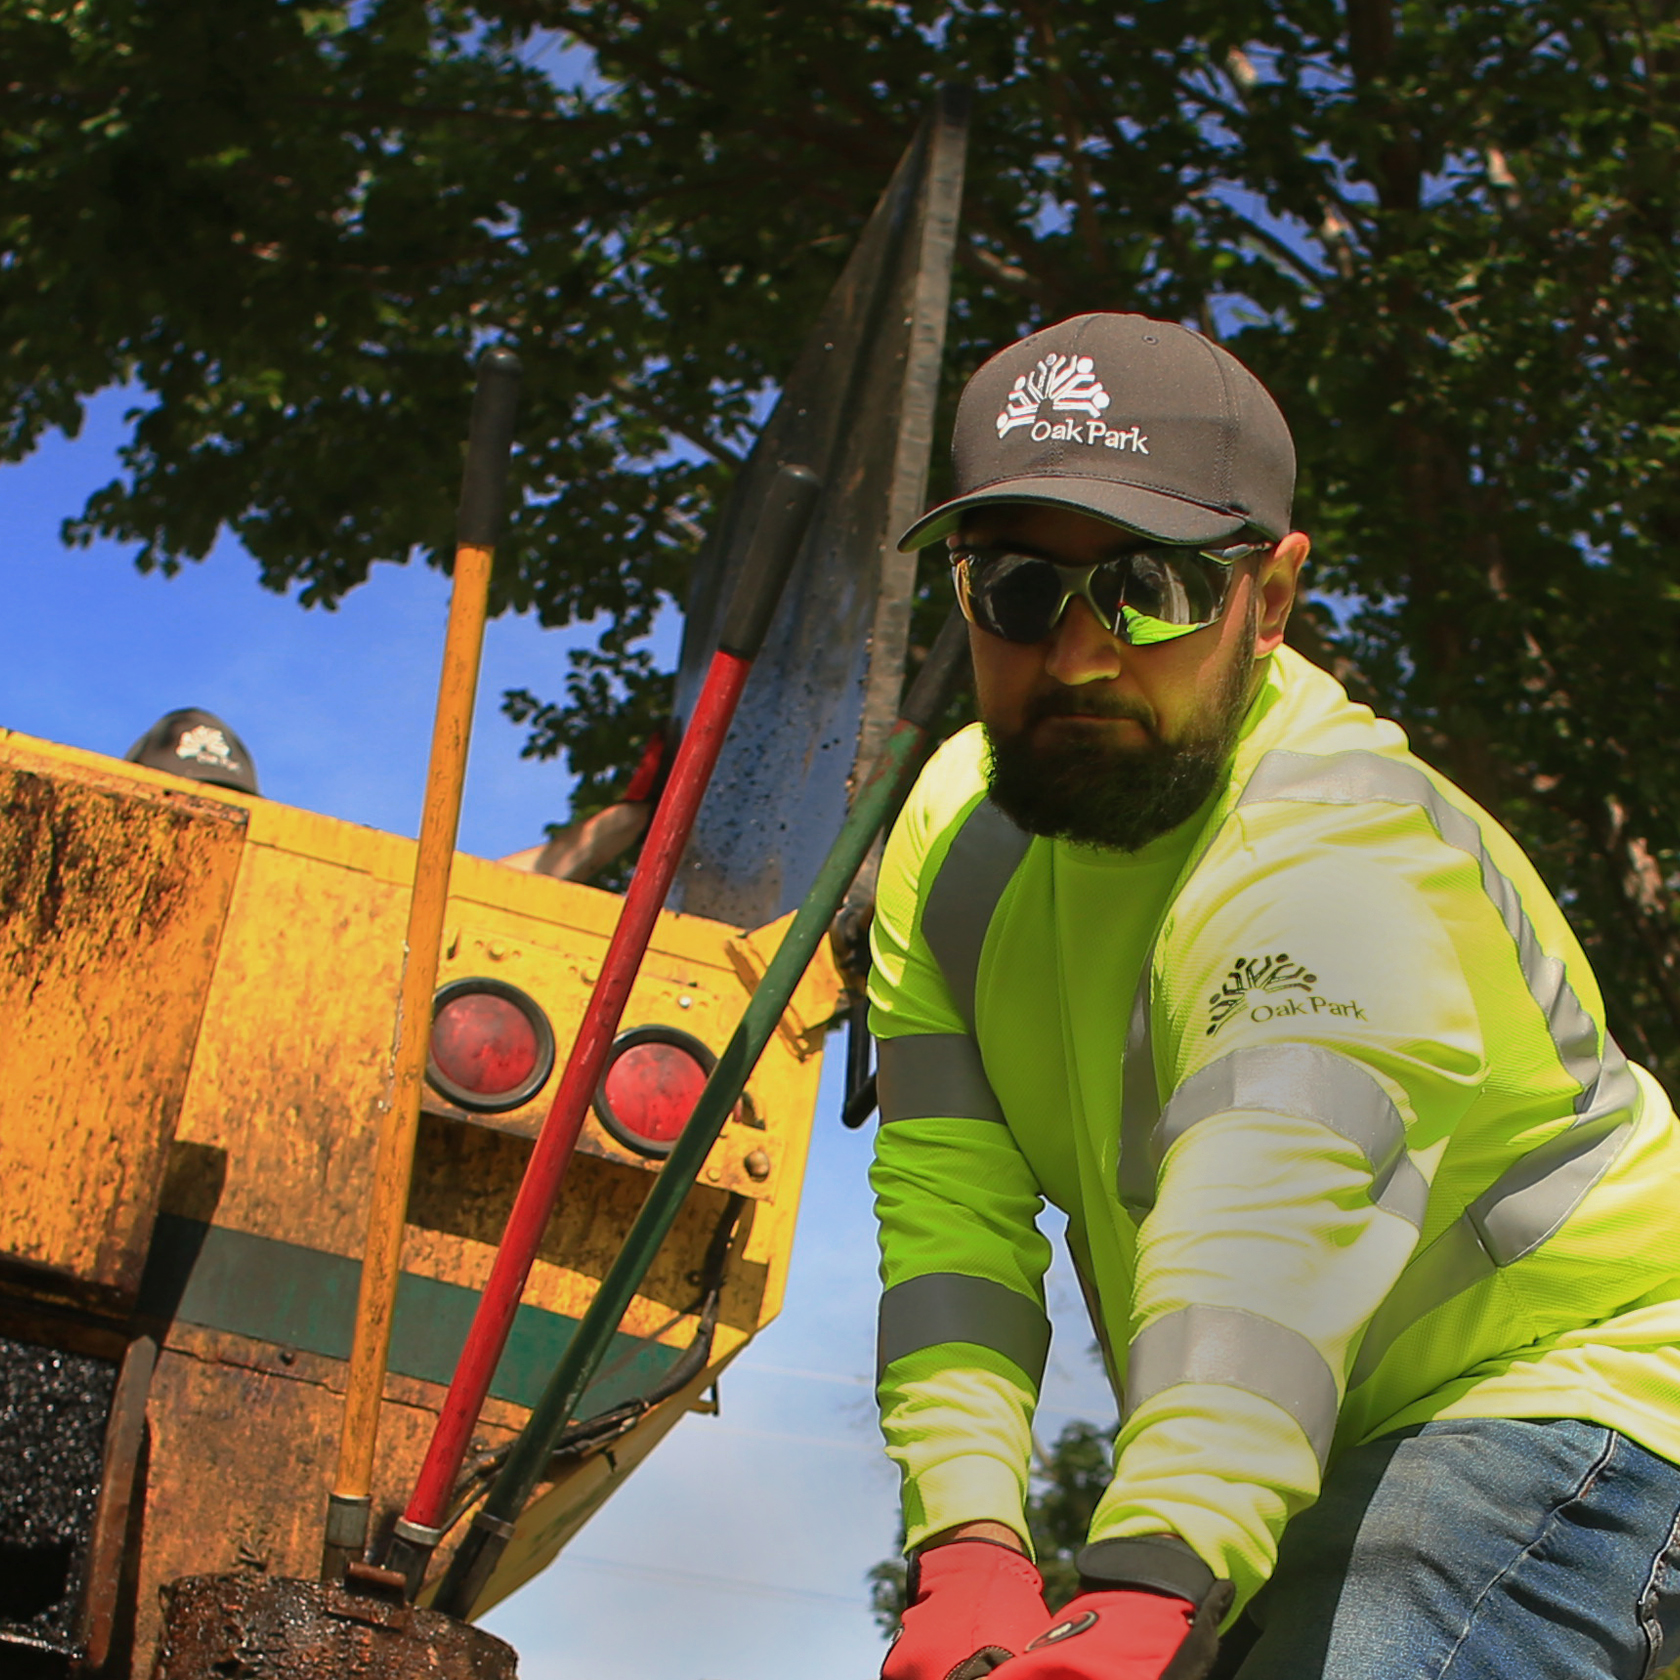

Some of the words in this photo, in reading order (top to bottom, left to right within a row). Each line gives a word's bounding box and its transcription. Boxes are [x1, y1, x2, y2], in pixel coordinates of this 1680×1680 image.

[1031, 419, 1083, 443] Oak
[1085, 419, 1150, 455] Park
[1250, 998, 1307, 1023] Oak
[1308, 996, 1369, 1022] Park
